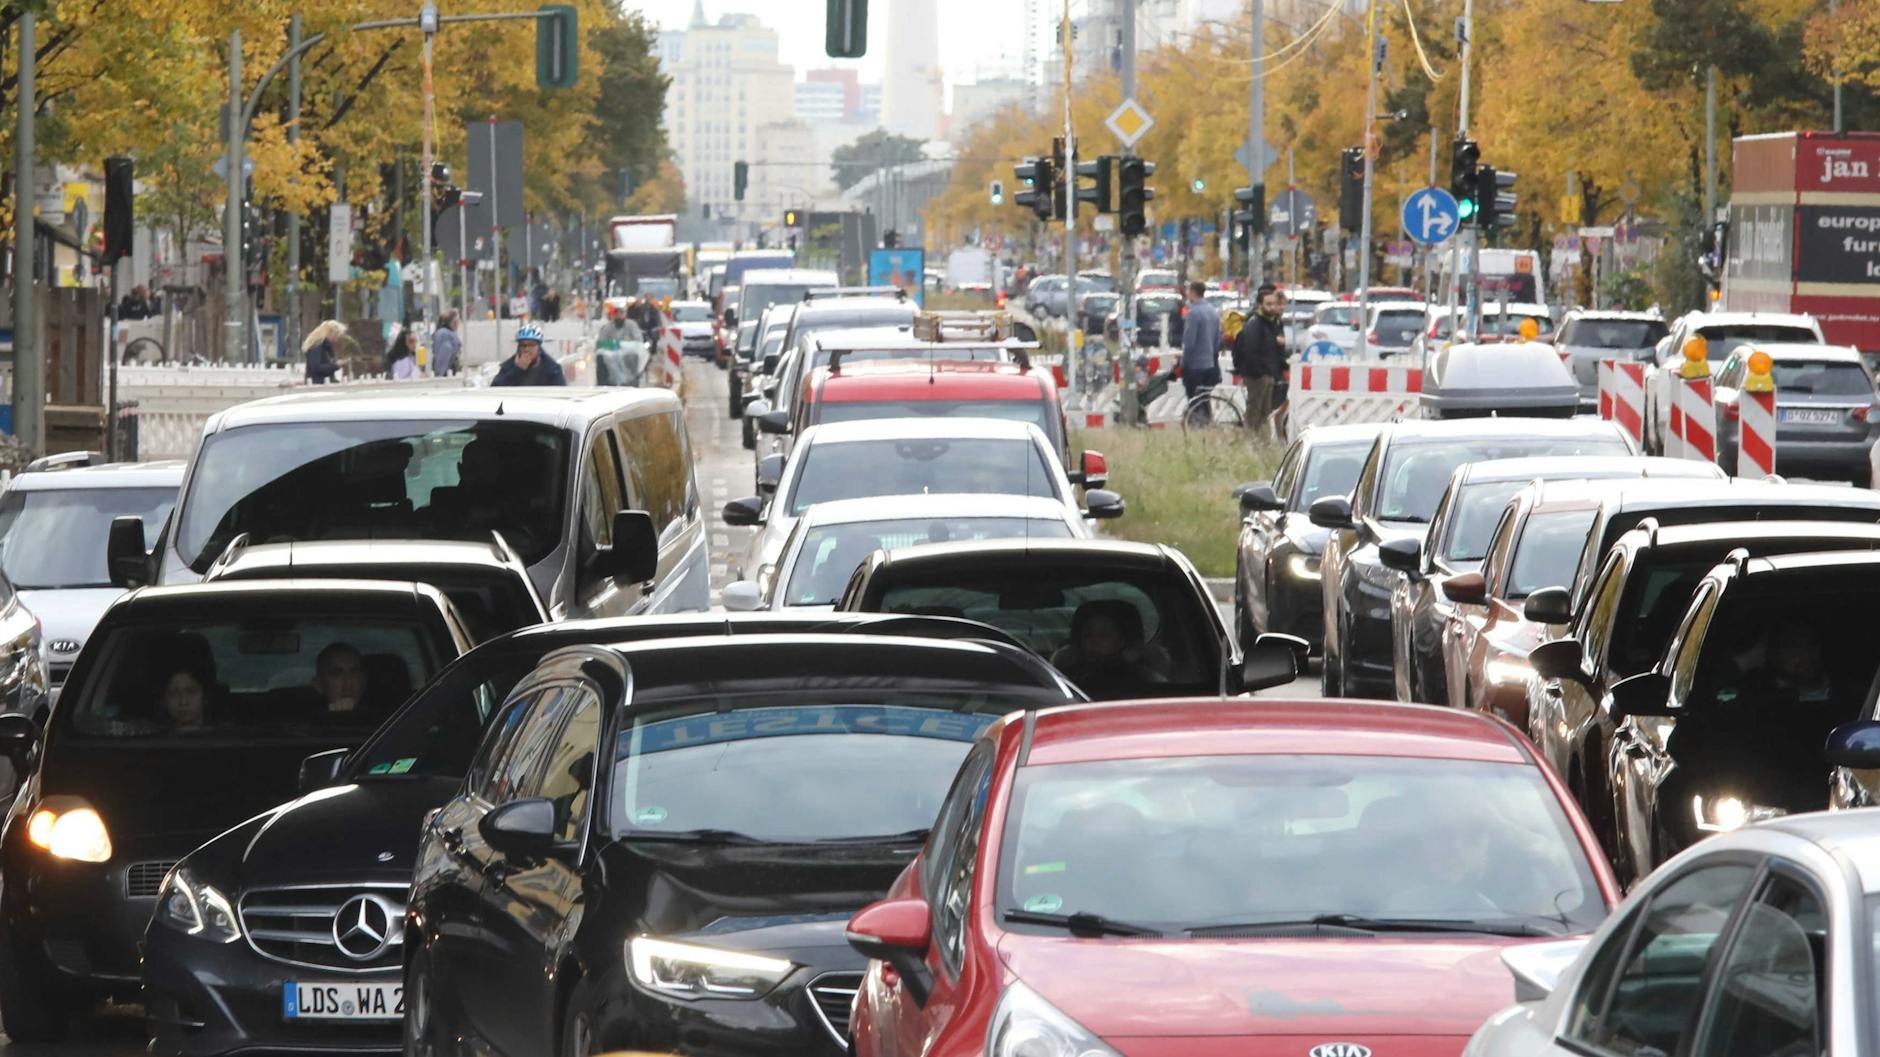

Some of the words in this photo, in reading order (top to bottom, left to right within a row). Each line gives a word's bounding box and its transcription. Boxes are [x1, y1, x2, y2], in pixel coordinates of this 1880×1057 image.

[1821, 156, 1869, 182] jan
[1843, 236, 1880, 252] fur
[298, 987, 339, 1013] LDS
[356, 987, 386, 1014] WA
